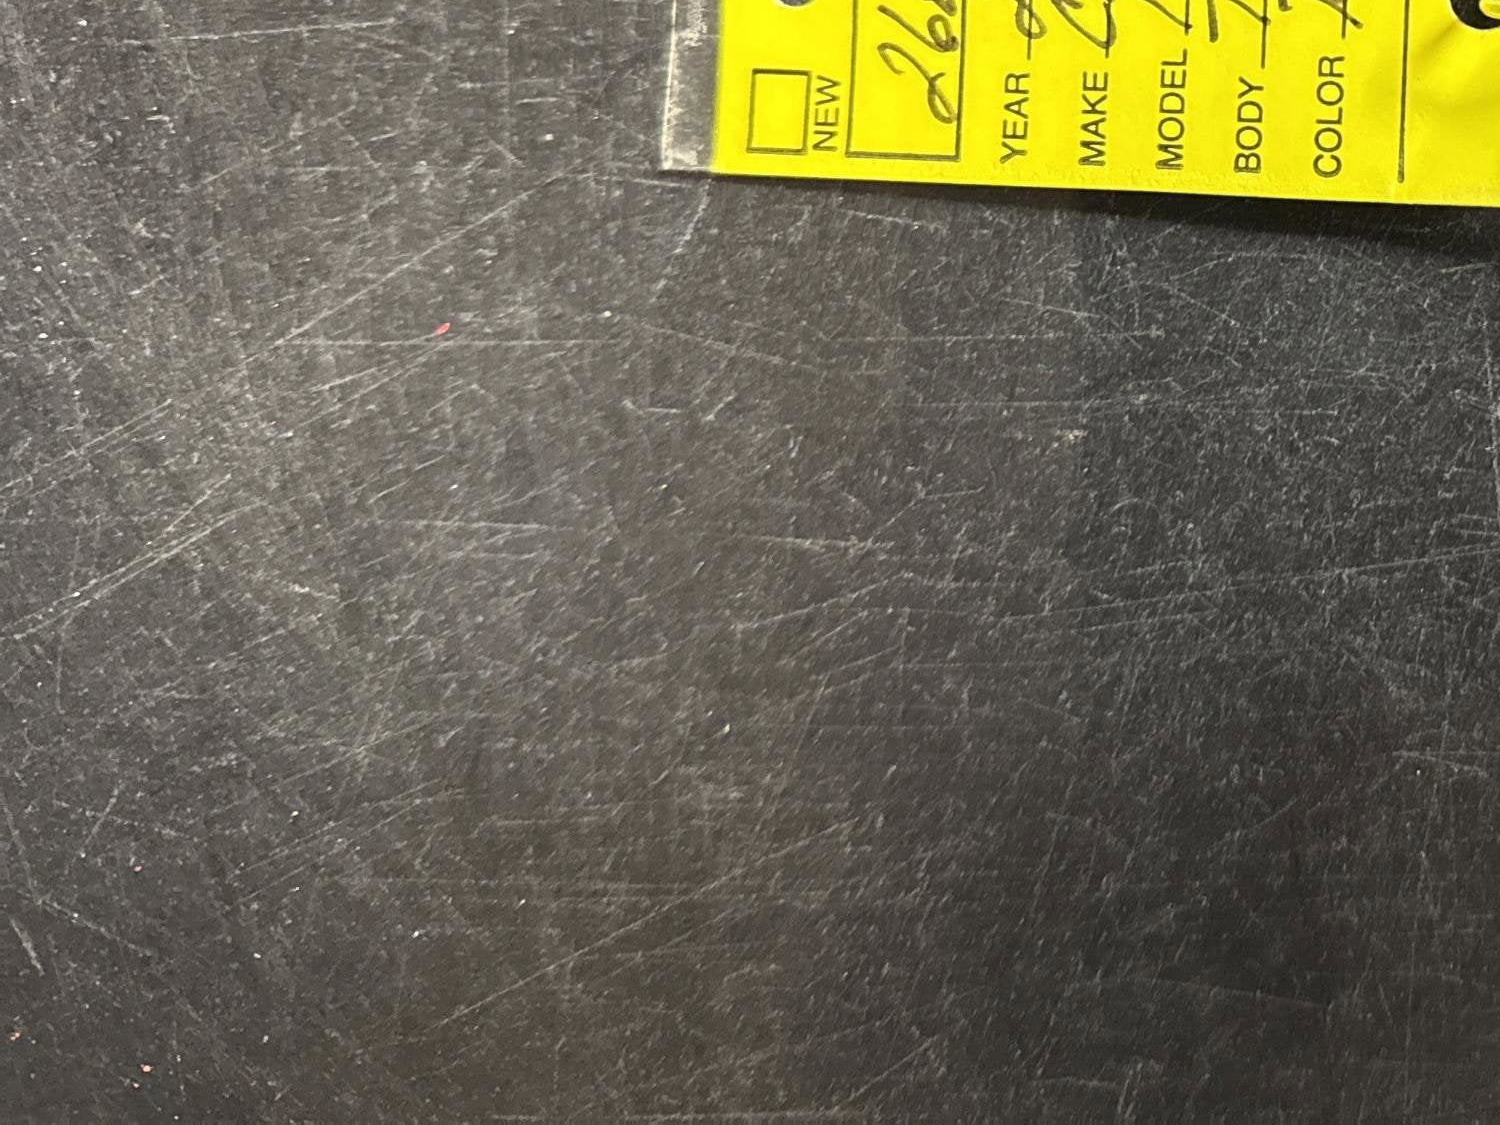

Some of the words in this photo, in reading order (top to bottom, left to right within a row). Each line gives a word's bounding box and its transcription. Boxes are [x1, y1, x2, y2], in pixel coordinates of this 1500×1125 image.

[812, 75, 842, 152] NEW
[1000, 72, 1031, 164] YEAR
[1079, 71, 1109, 166] MAKE
[1156, 48, 1188, 170] MODEL
[1234, 76, 1265, 173] BODY
[1313, 55, 1345, 178] COLOR
